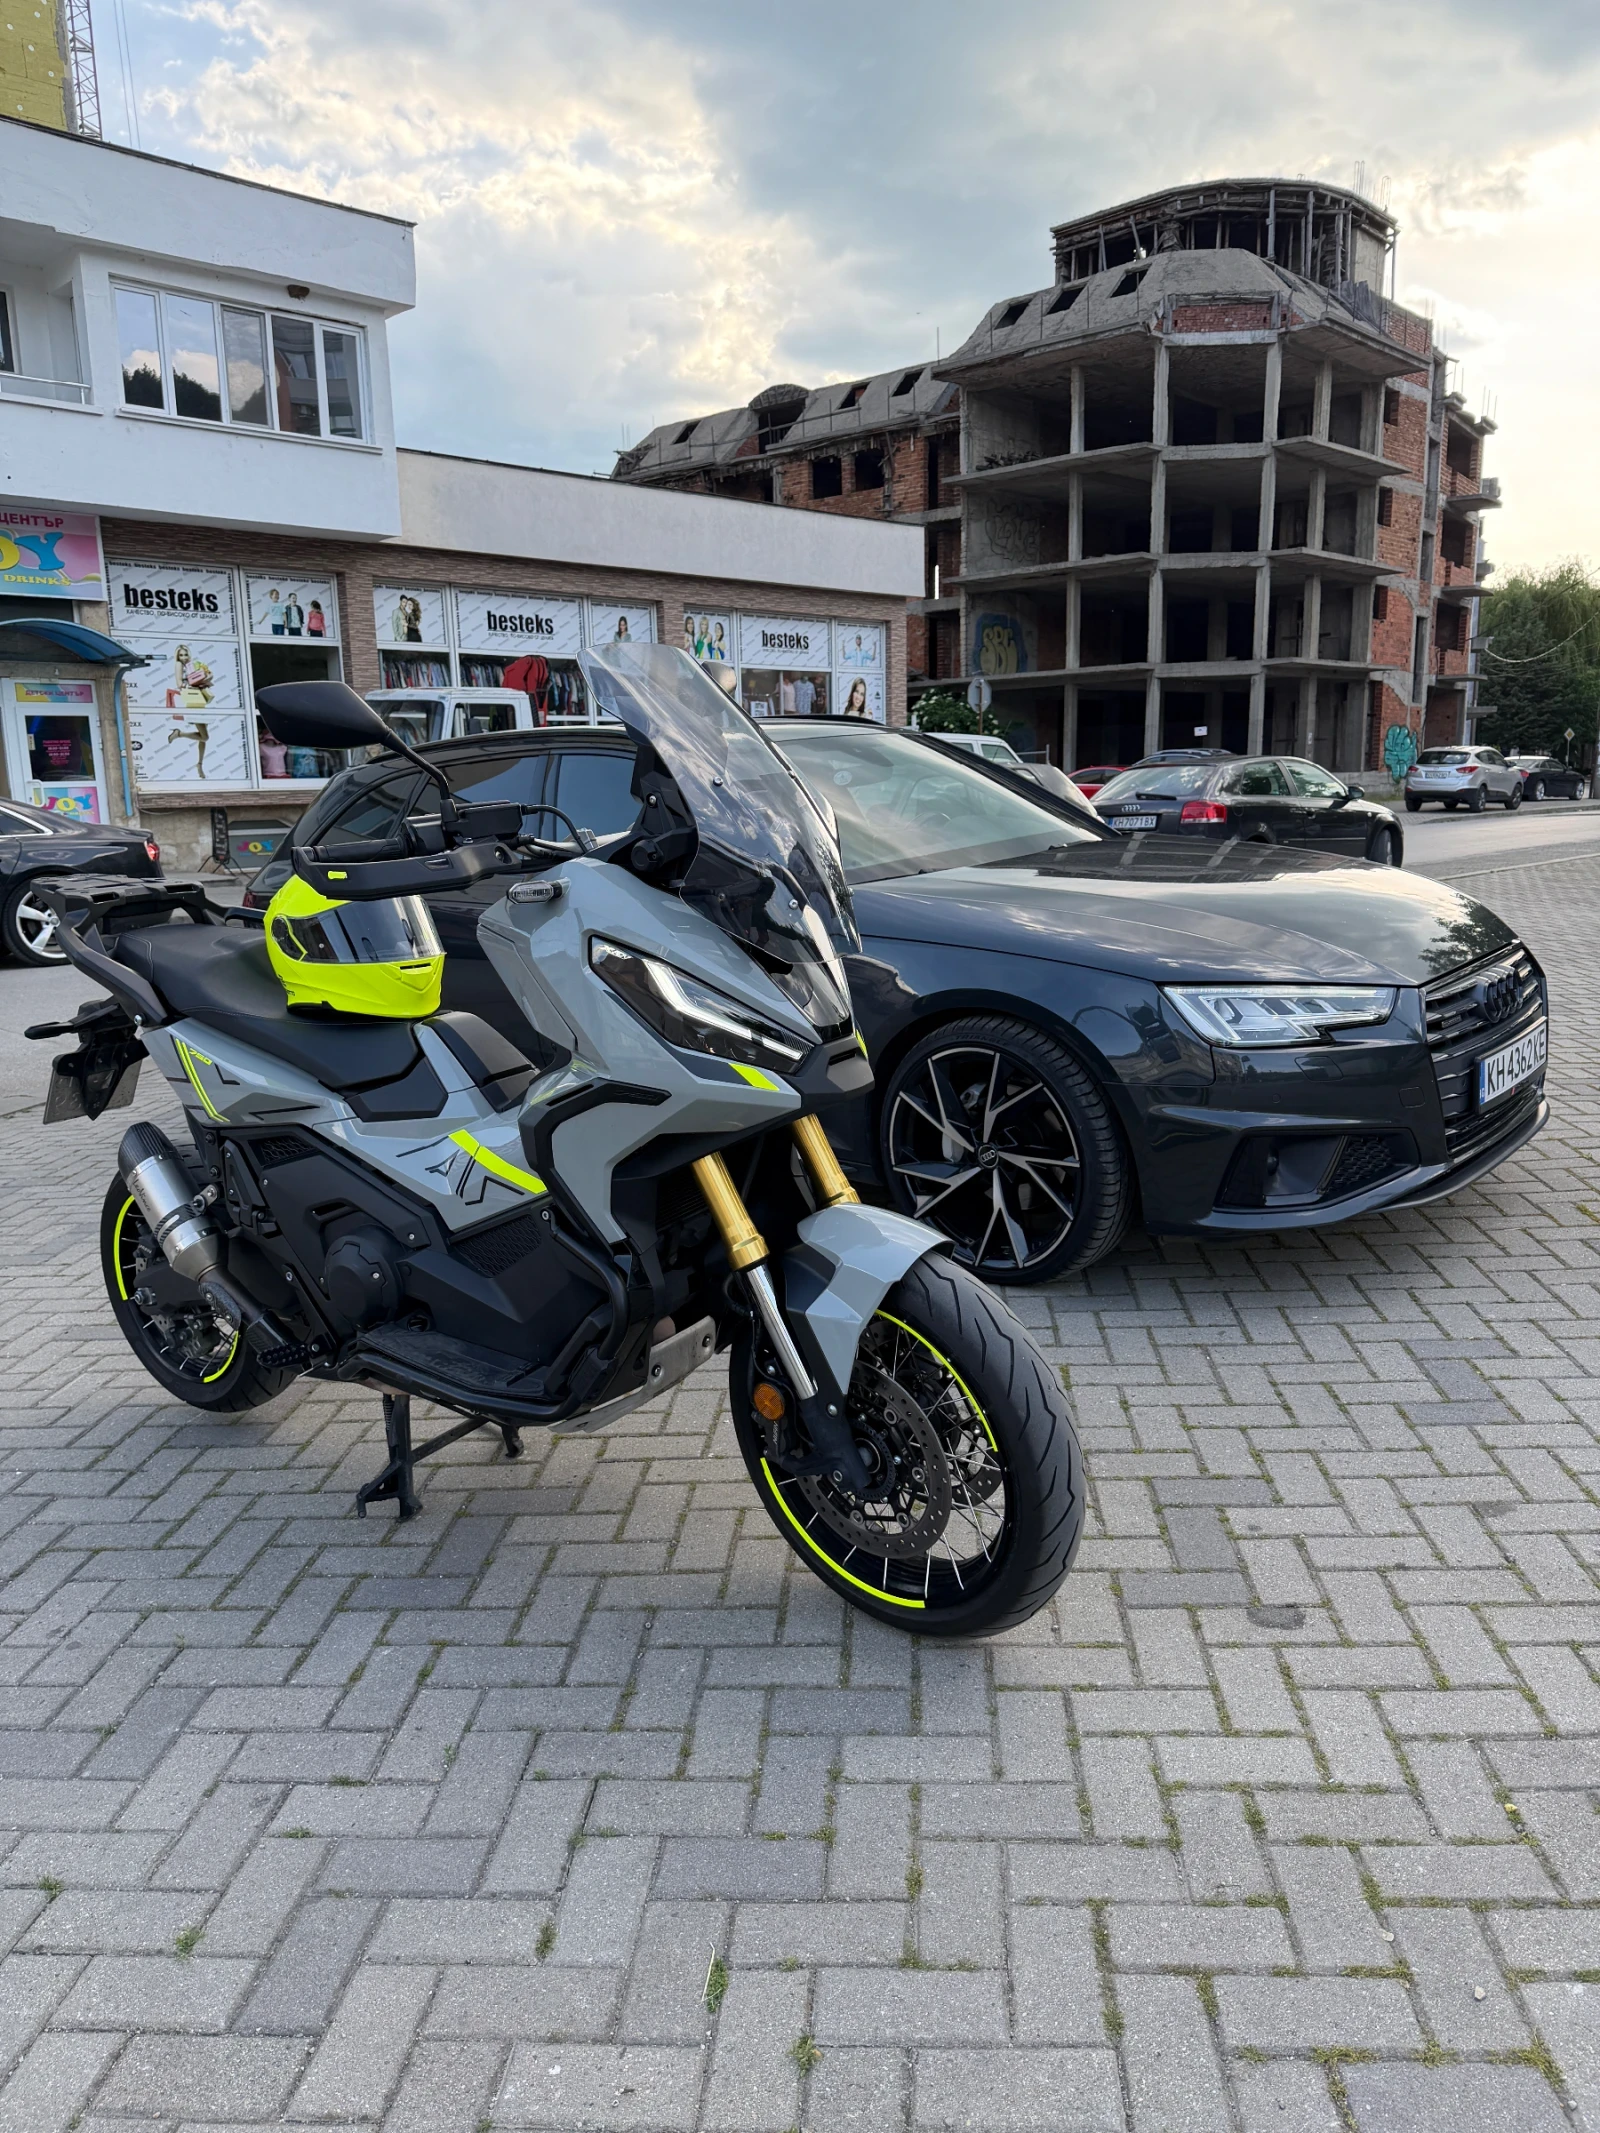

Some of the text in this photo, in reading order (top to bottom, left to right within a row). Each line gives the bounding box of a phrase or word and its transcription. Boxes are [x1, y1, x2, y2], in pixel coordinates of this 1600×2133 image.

[4, 574, 71, 586] DRINKS
[124, 584, 218, 612] besteks
[487, 610, 554, 634] besteks
[762, 630, 809, 649] besteks
[42, 793, 93, 811] JOY
[237, 840, 273, 852] JOY
